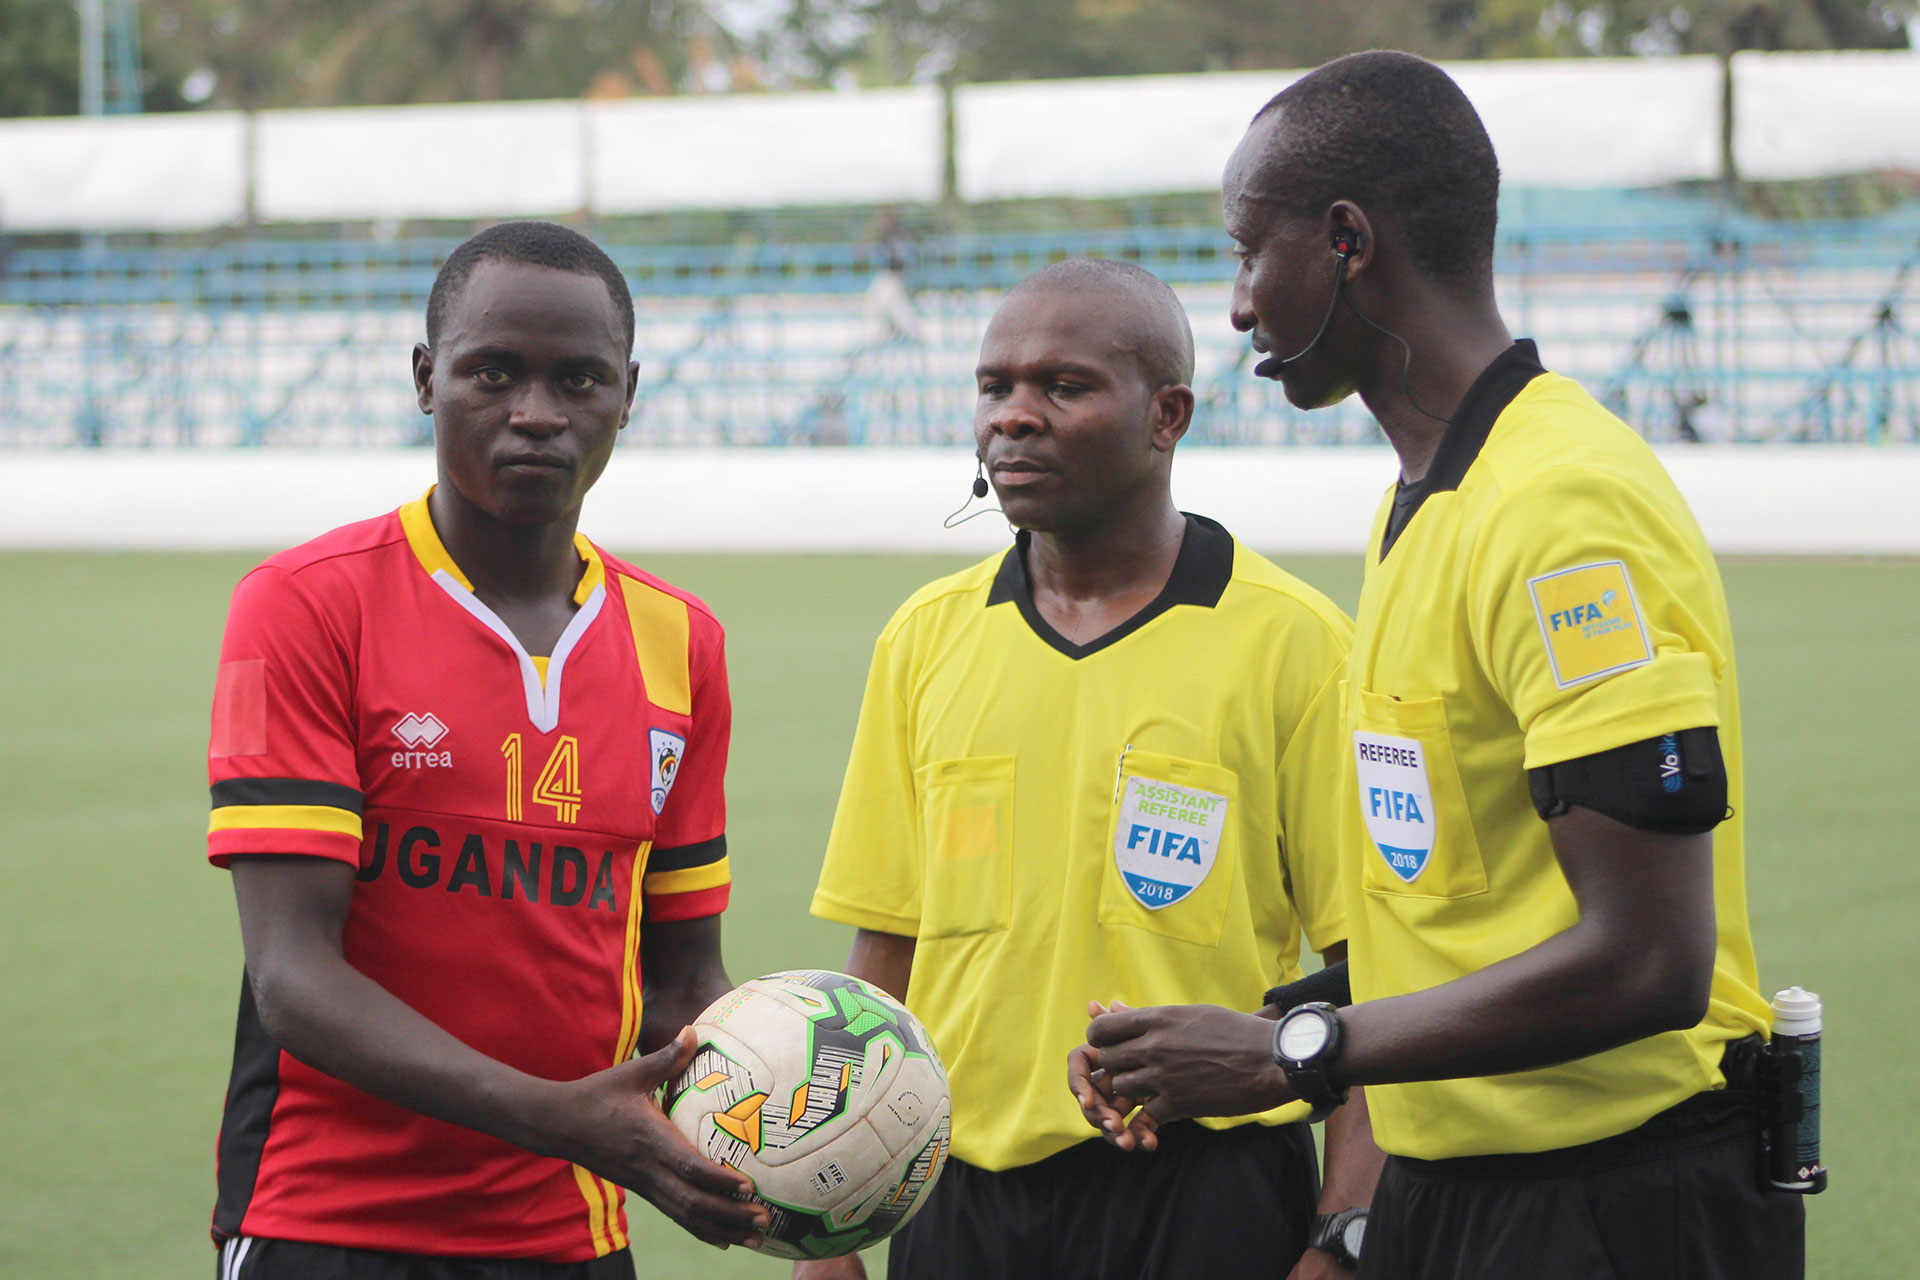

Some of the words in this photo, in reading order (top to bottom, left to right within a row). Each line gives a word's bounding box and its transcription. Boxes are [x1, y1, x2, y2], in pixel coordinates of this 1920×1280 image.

[1549, 602, 1603, 632] FIFA
[391, 751, 453, 769] errea
[1358, 742, 1419, 768] REFEREE
[501, 733, 582, 824] 14
[1135, 784, 1219, 813] ASSISTANT
[1368, 786, 1425, 824] FIFA
[1137, 800, 1208, 827] REFEREE
[1127, 823, 1202, 865] FIFA
[356, 822, 616, 913] UGANDA
[1390, 851, 1418, 869] 2018
[1137, 881, 1174, 901] 2018
[828, 1163, 844, 1184] FIFA
